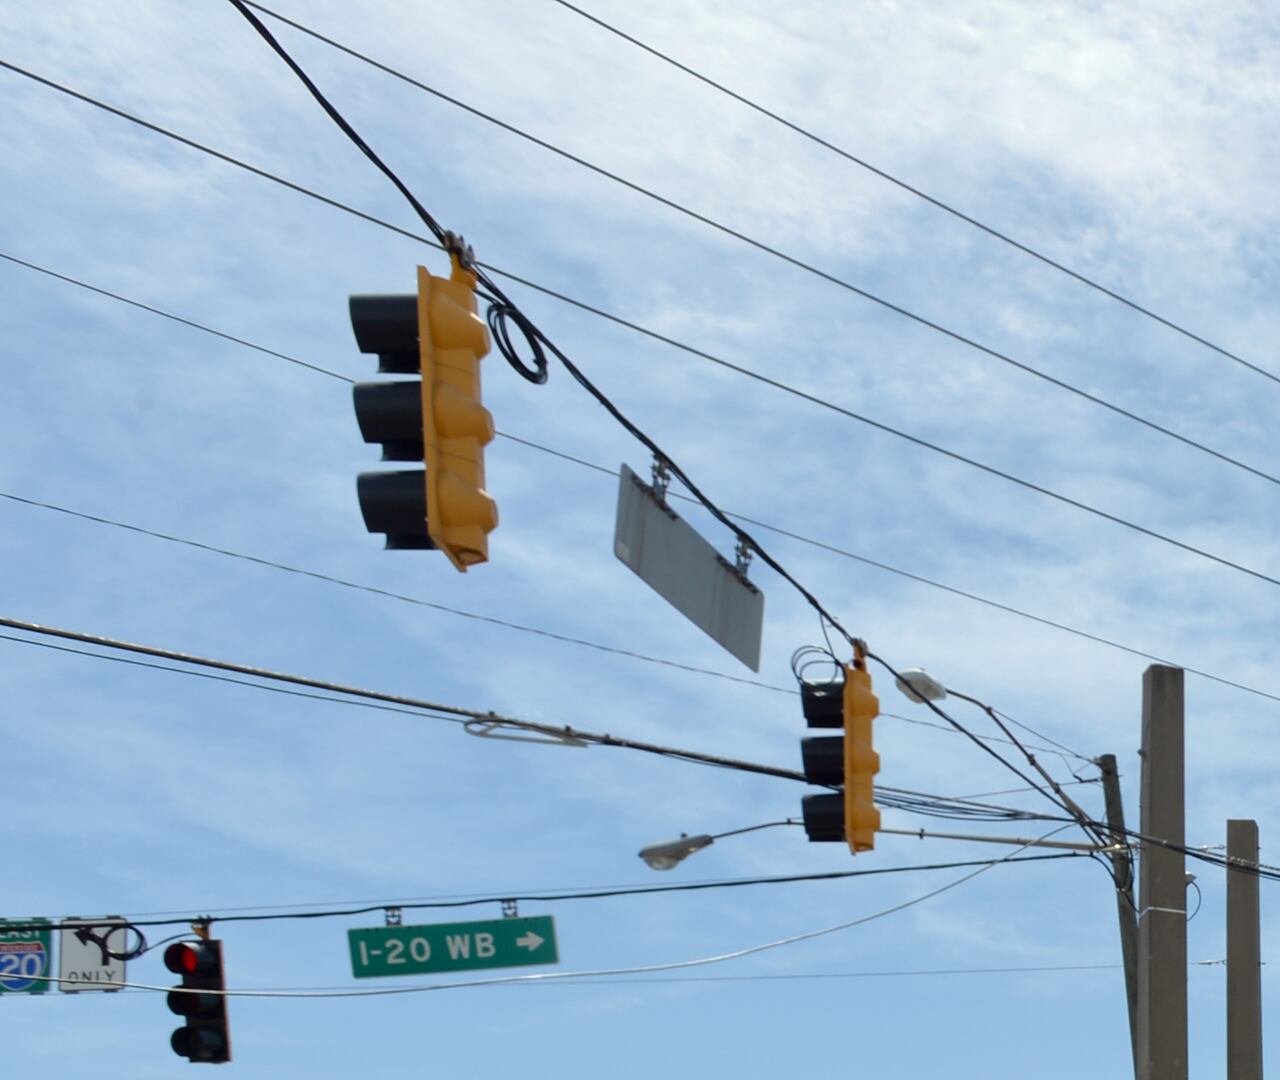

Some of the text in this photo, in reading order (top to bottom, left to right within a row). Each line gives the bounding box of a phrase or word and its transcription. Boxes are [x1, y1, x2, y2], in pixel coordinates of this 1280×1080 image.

[359, 932, 496, 966] I-20 WB
[0, 953, 42, 981] 20
